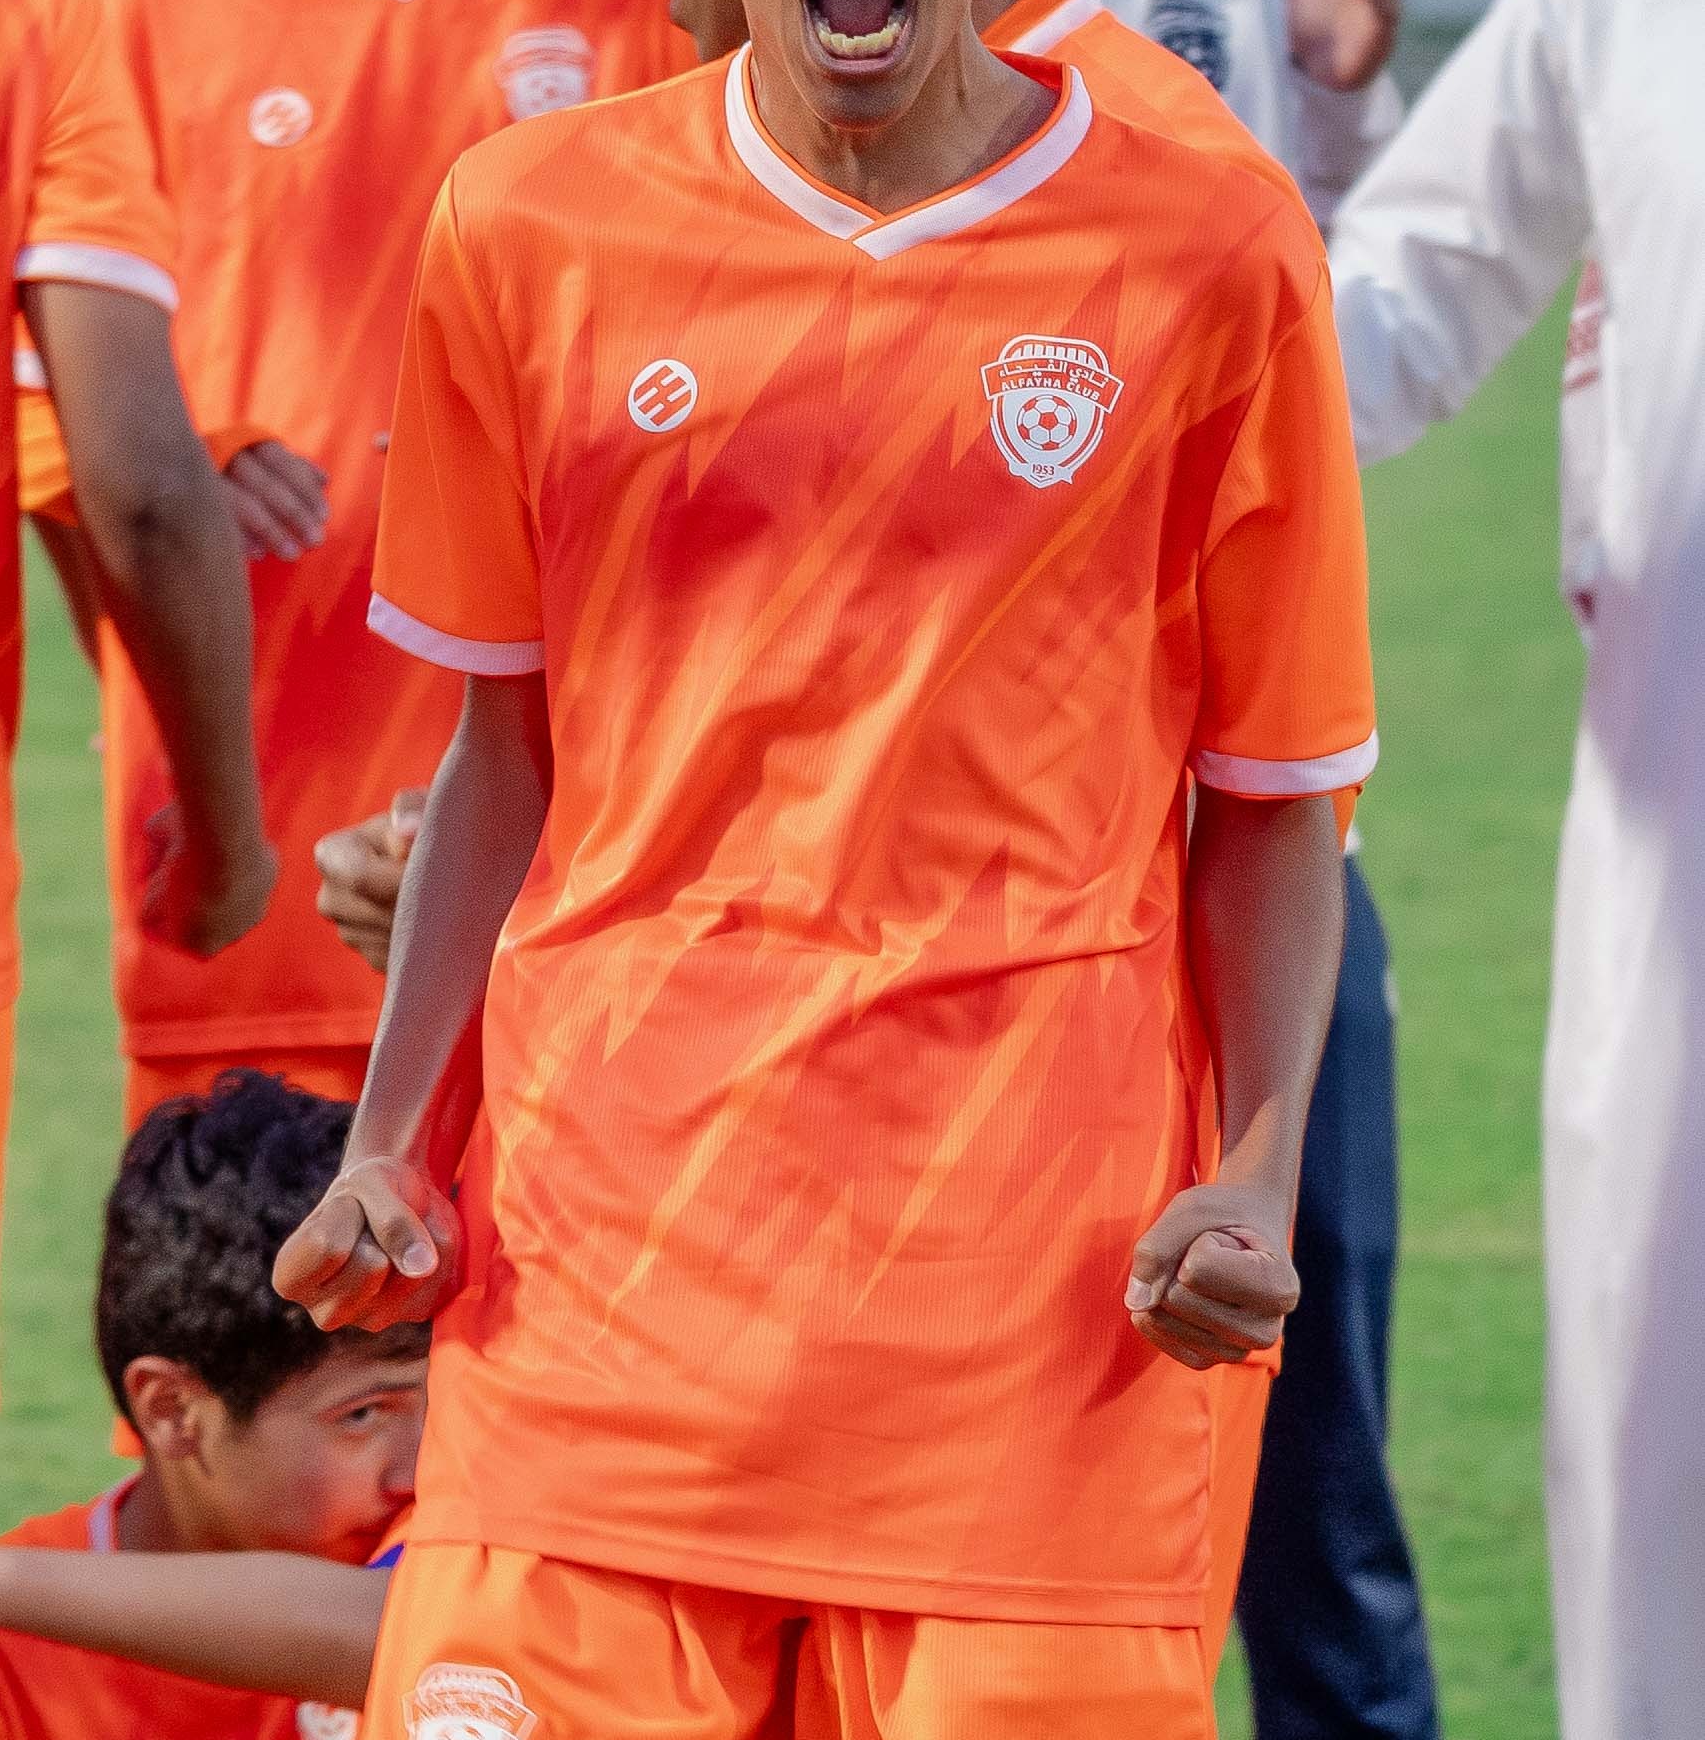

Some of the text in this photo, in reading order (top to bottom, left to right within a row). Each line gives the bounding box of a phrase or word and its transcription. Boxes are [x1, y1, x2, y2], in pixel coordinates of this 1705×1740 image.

[1001, 377, 1101, 402] ALFAYHA CLUB
[1031, 463, 1056, 476] 1953
